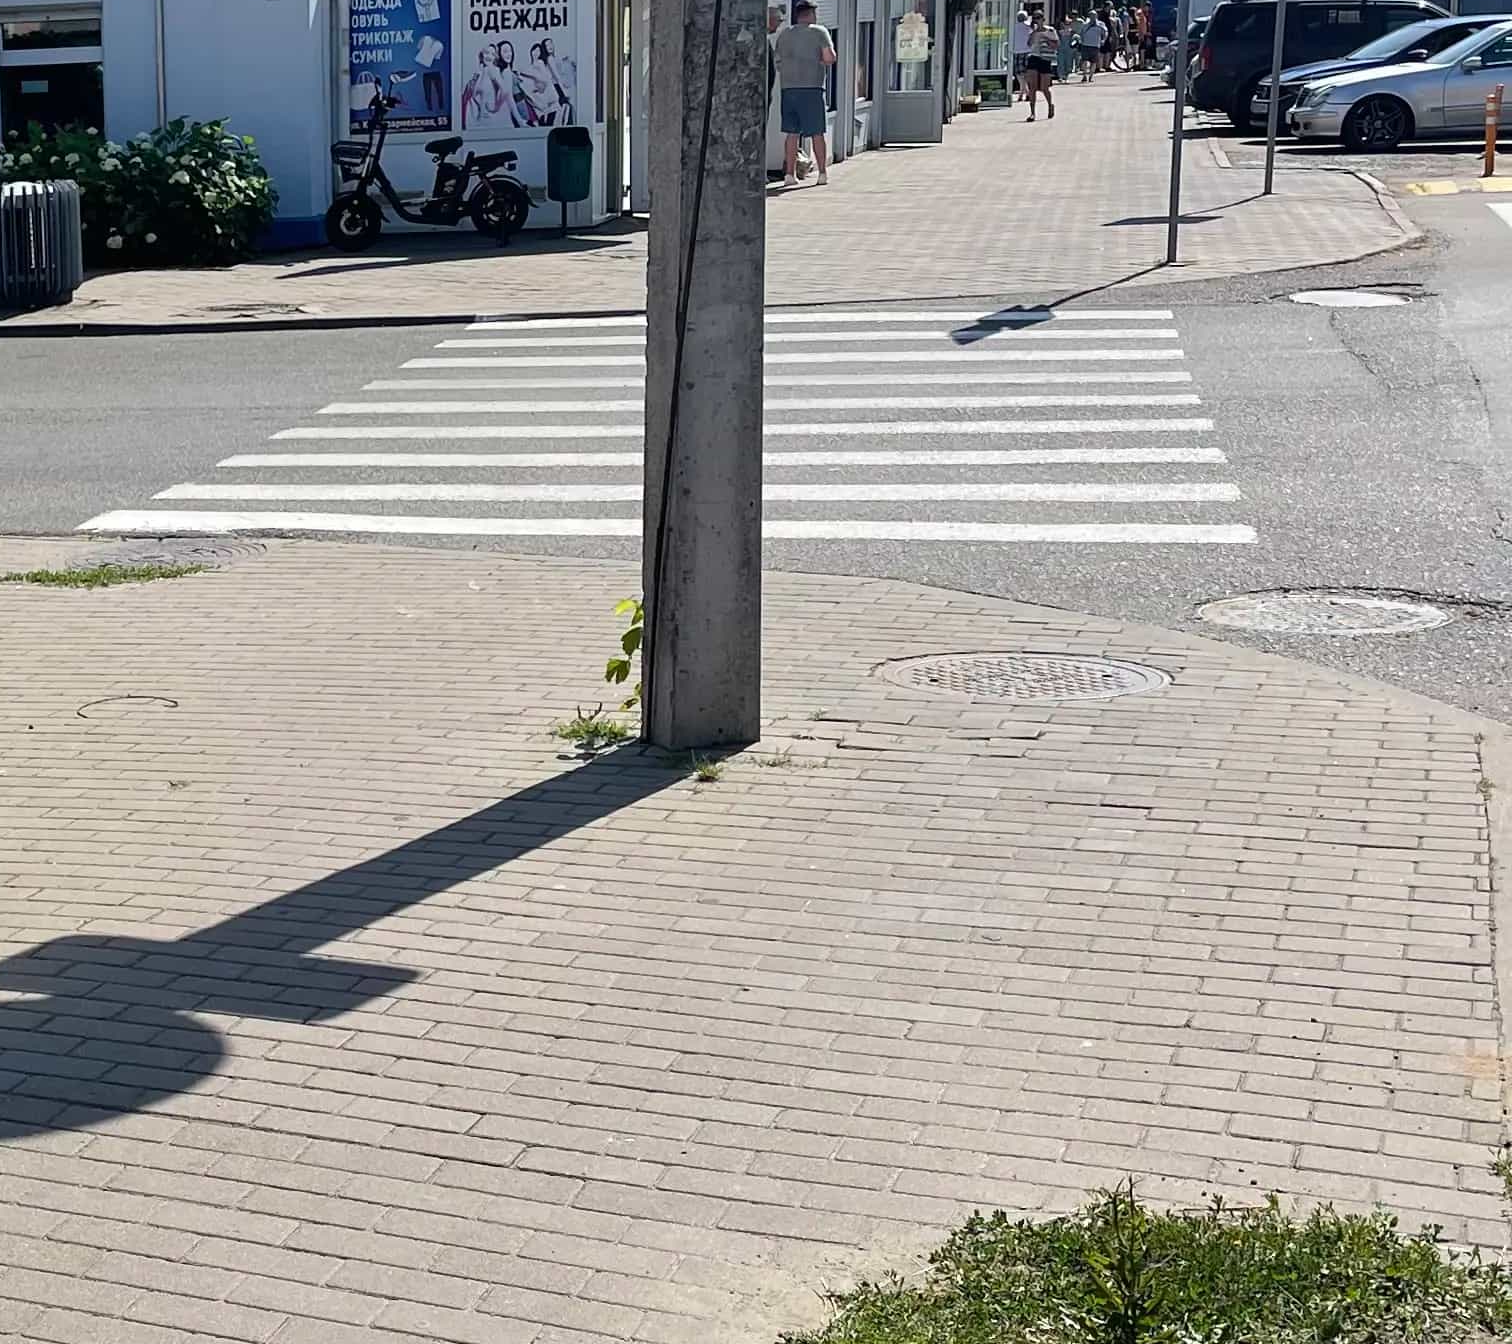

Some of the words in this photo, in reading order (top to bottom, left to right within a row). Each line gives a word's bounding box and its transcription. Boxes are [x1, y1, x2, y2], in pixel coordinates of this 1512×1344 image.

[470, 6, 568, 34] ОДЕЖДЫ
[351, 30, 414, 46] ТРИКОТАЖ
[351, 49, 393, 64] СУМКИ
